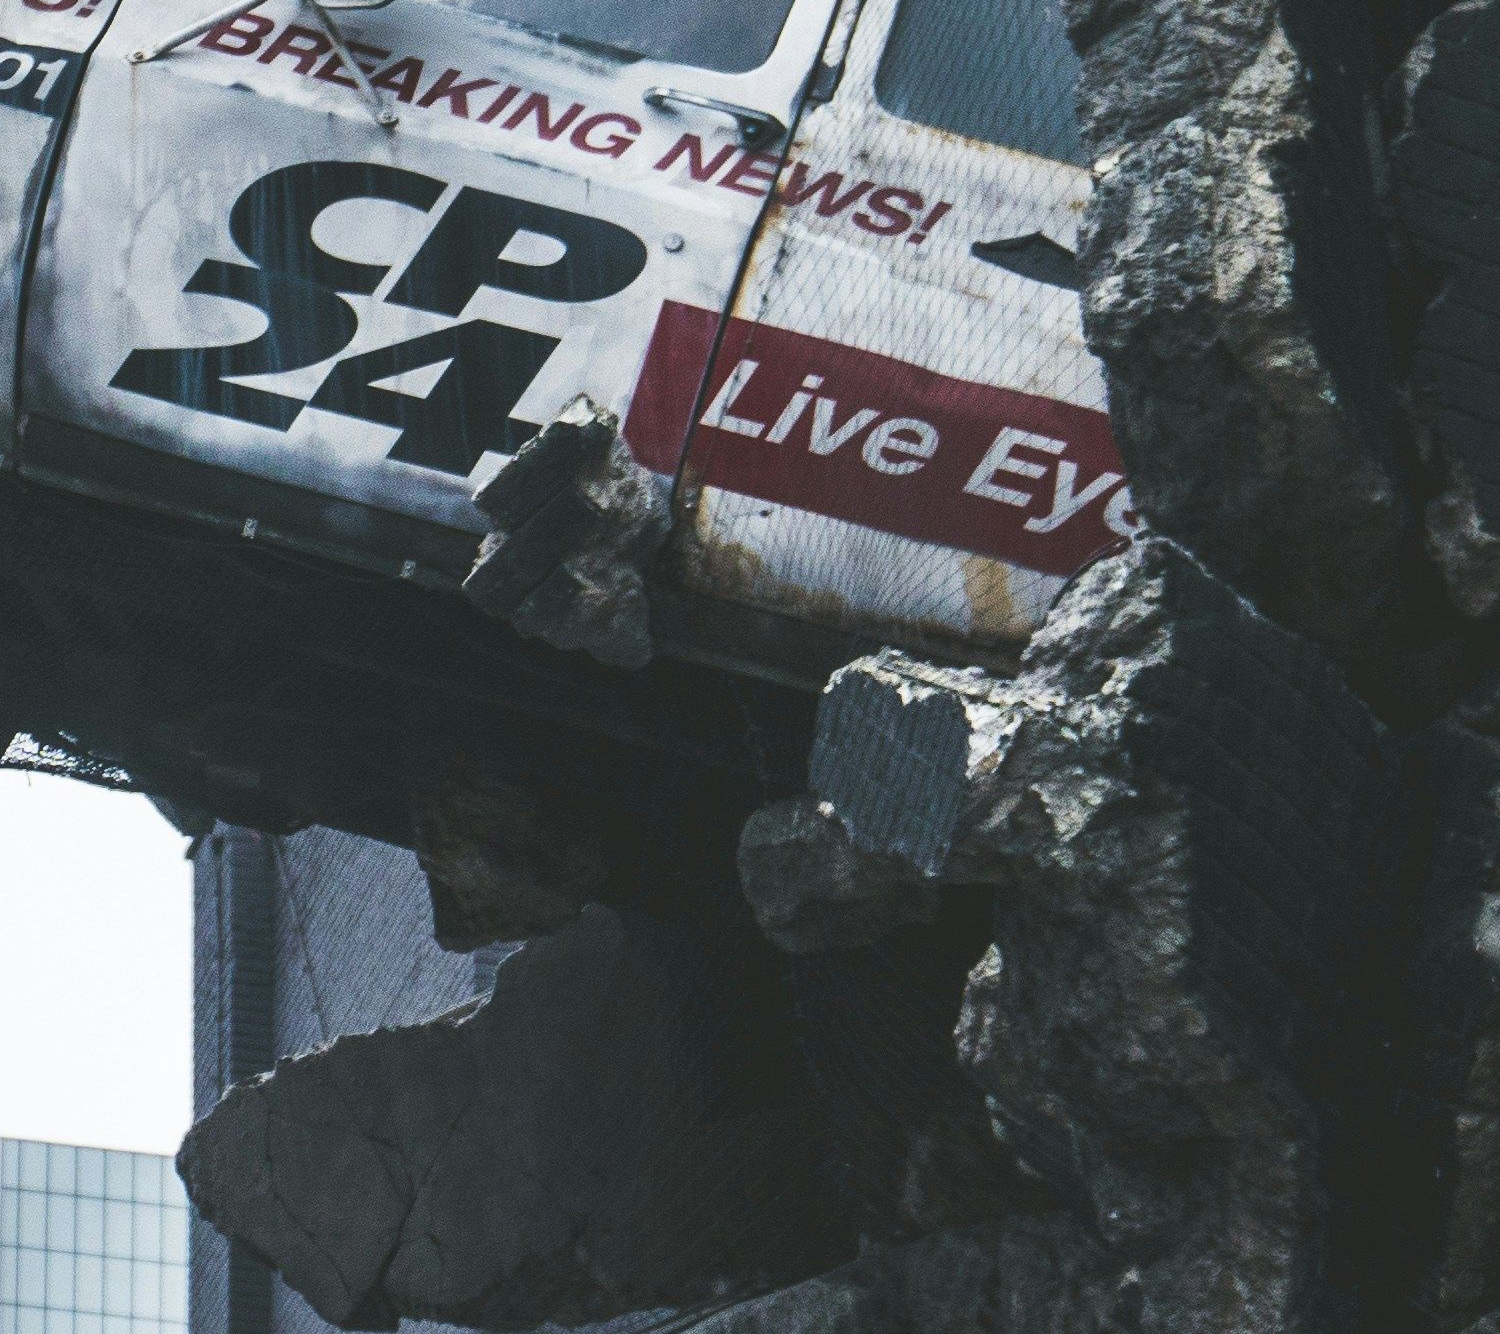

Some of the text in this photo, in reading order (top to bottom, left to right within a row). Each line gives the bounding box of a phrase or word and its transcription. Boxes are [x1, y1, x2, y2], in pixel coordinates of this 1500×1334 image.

[198, 11, 953, 245] BREAKING NEWS!
[228, 160, 648, 319] CP
[108, 257, 562, 478] 24
[699, 358, 941, 476] Live
